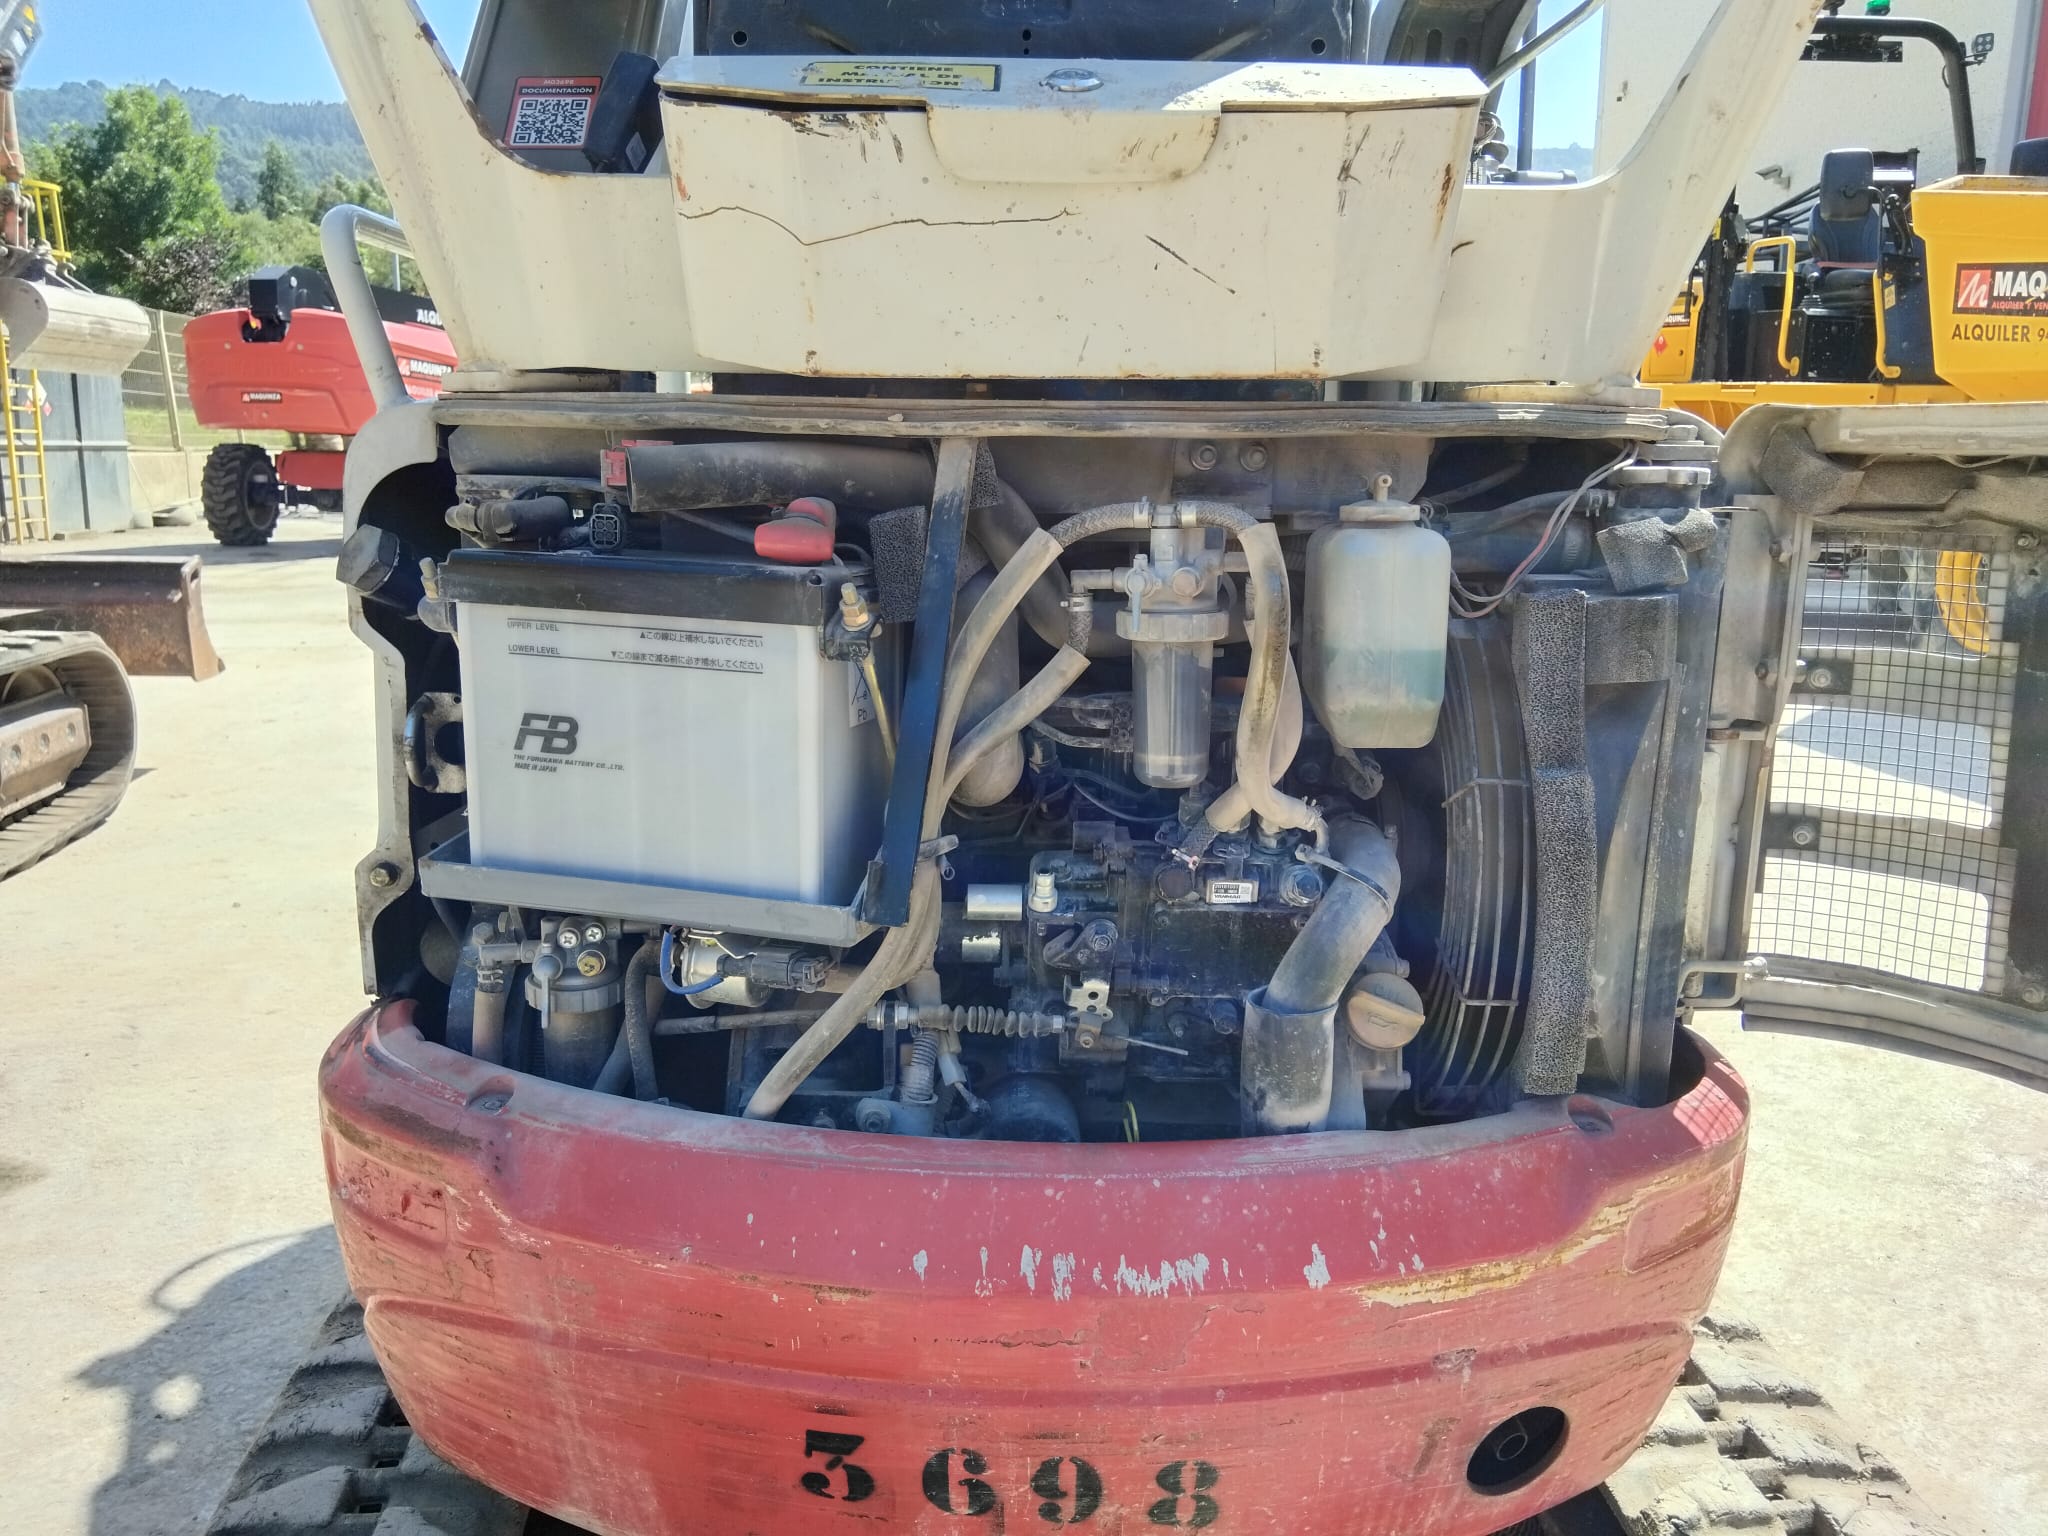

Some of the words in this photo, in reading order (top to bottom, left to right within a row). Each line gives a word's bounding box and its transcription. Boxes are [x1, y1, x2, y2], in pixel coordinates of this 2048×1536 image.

[1991, 301, 2024, 310] ALQUILER
[1951, 323, 2030, 342] ALQUILER
[507, 620, 532, 629] UPPER
[535, 622, 560, 632] LEVEL
[508, 644, 535, 653] LOWER
[536, 646, 560, 655] LEVEL
[513, 712, 579, 755] FB
[513, 753, 526, 761] THE
[564, 759, 594, 768] BATTERY
[514, 762, 530, 770] MADE
[538, 764, 558, 773] JAPAN
[800, 1429, 1220, 1529] 3698
